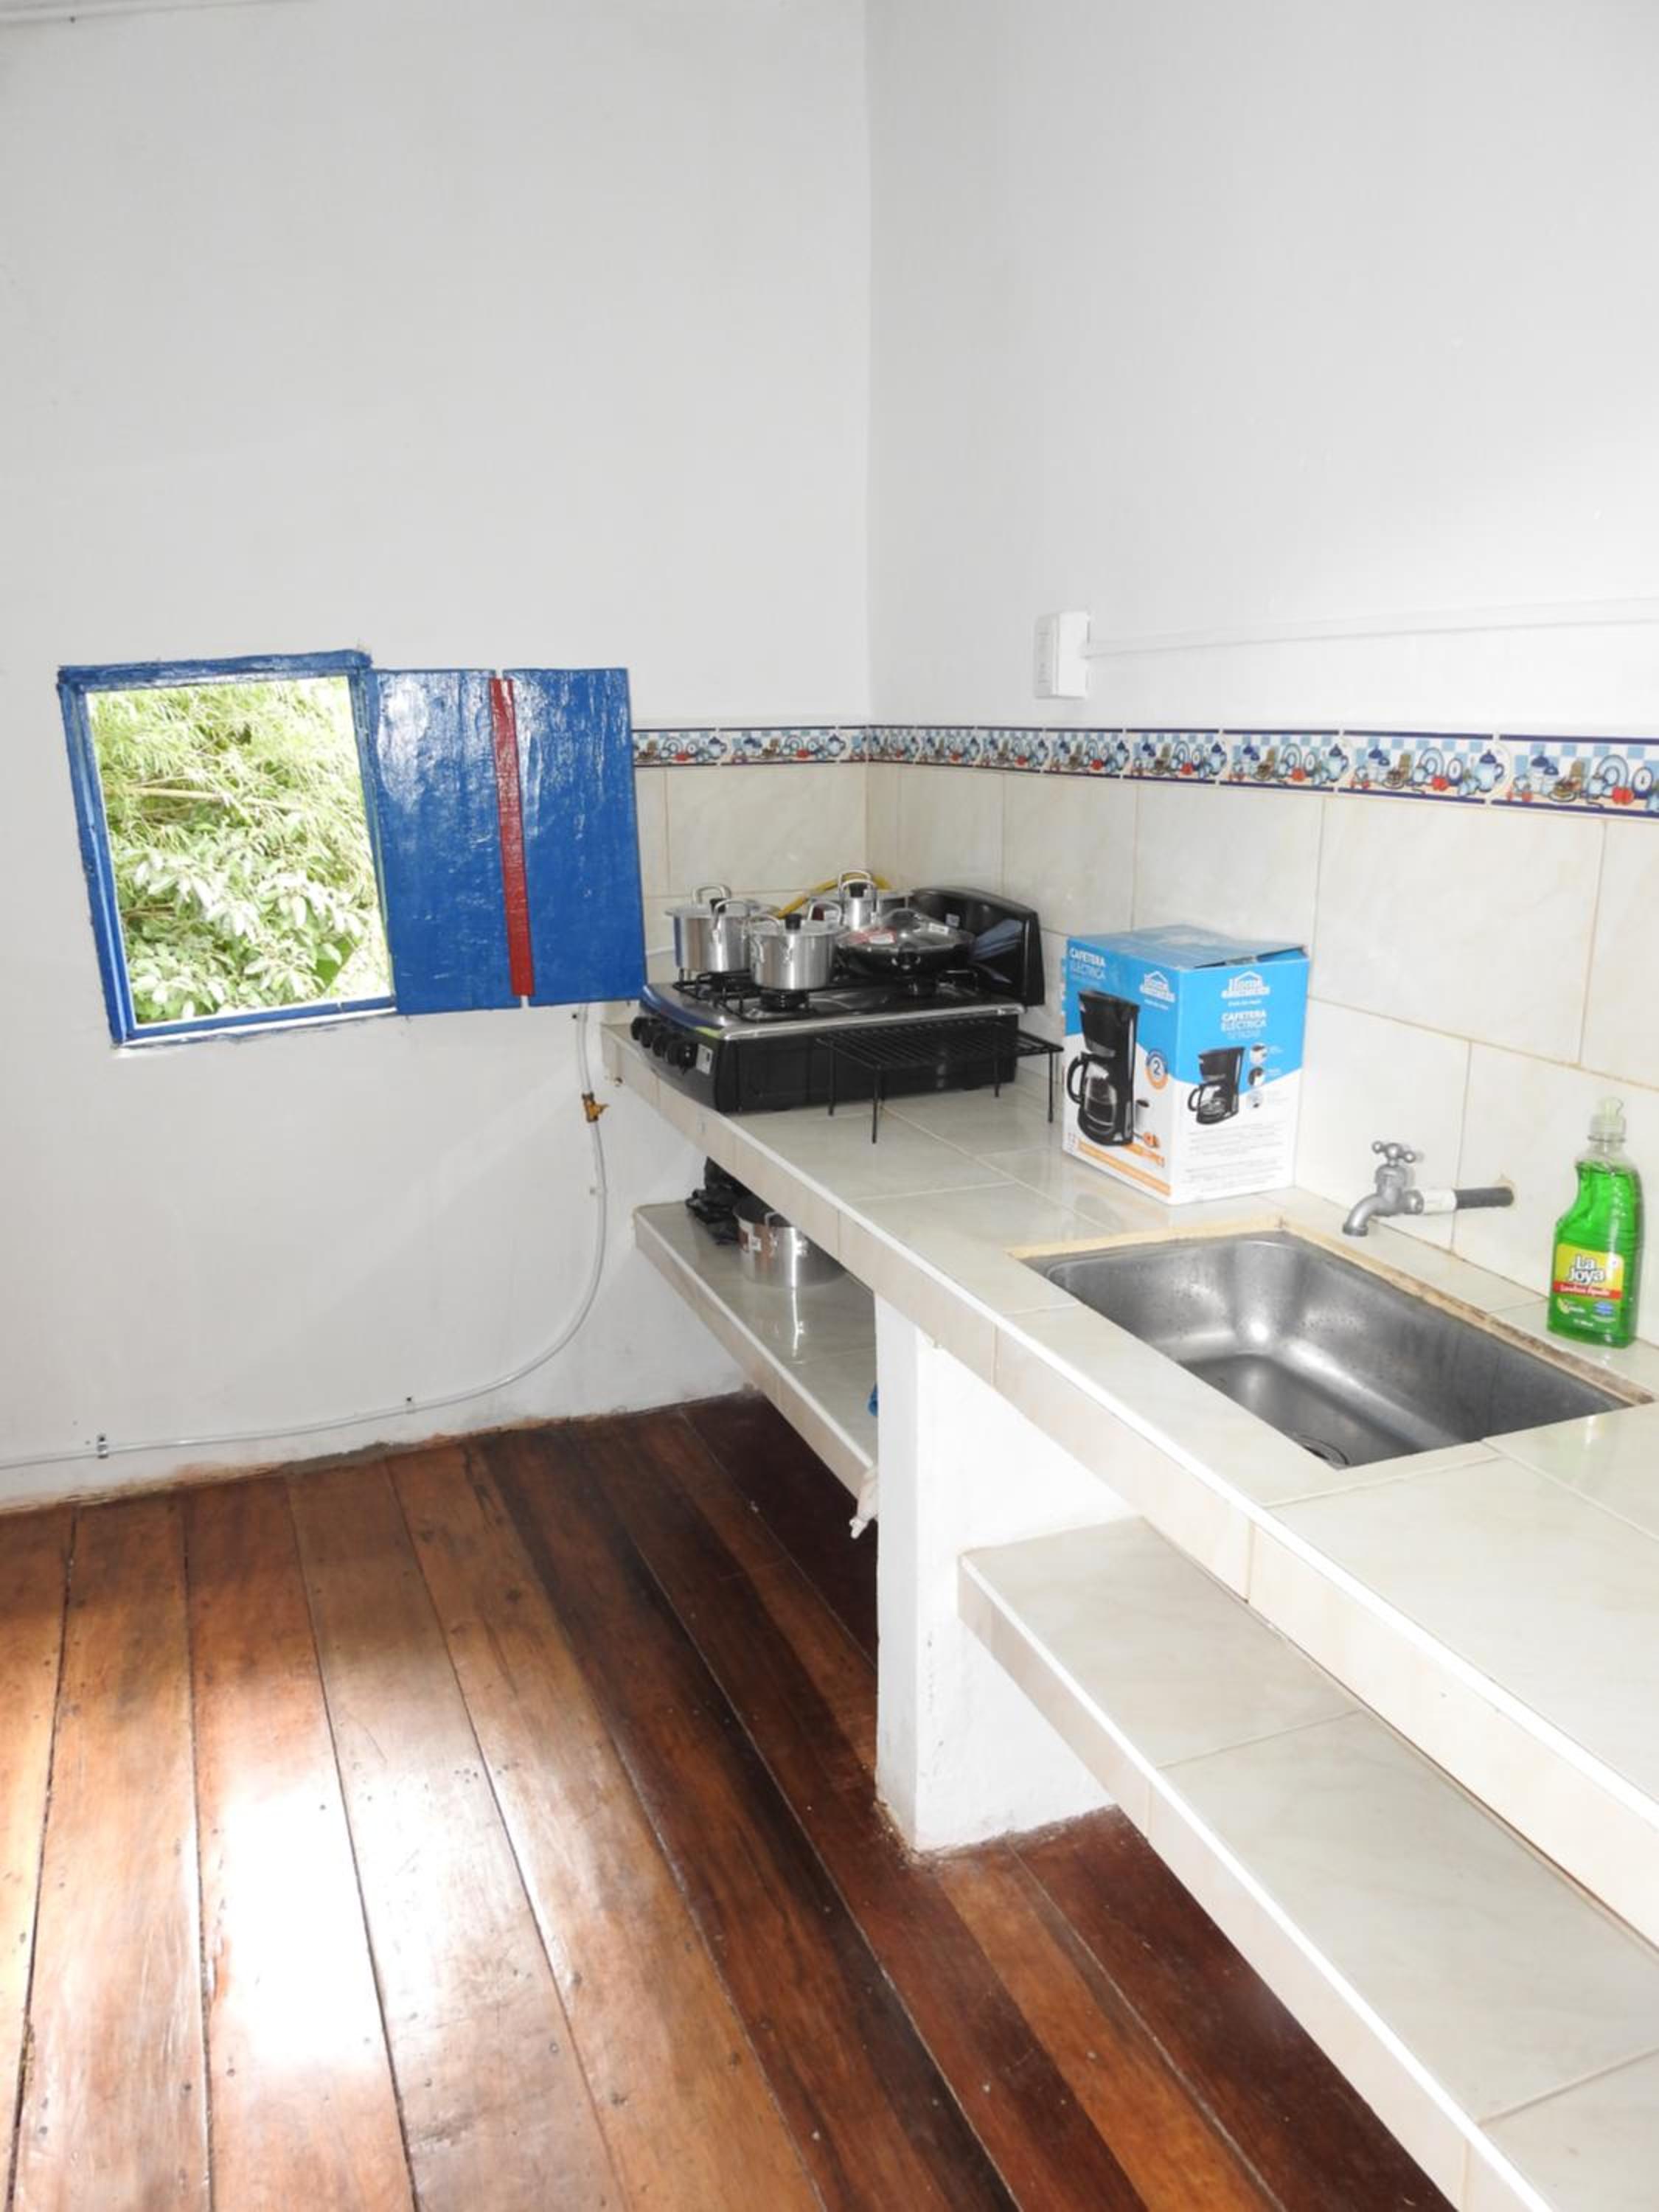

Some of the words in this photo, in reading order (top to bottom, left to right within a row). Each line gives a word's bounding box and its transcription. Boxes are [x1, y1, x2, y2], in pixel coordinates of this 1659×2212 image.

[1221, 1010, 1267, 1022] CAFETERA
[1152, 1060, 1161, 1075] 2
[1576, 1255, 1595, 1270] La
[1570, 1267, 1605, 1284] Joya
